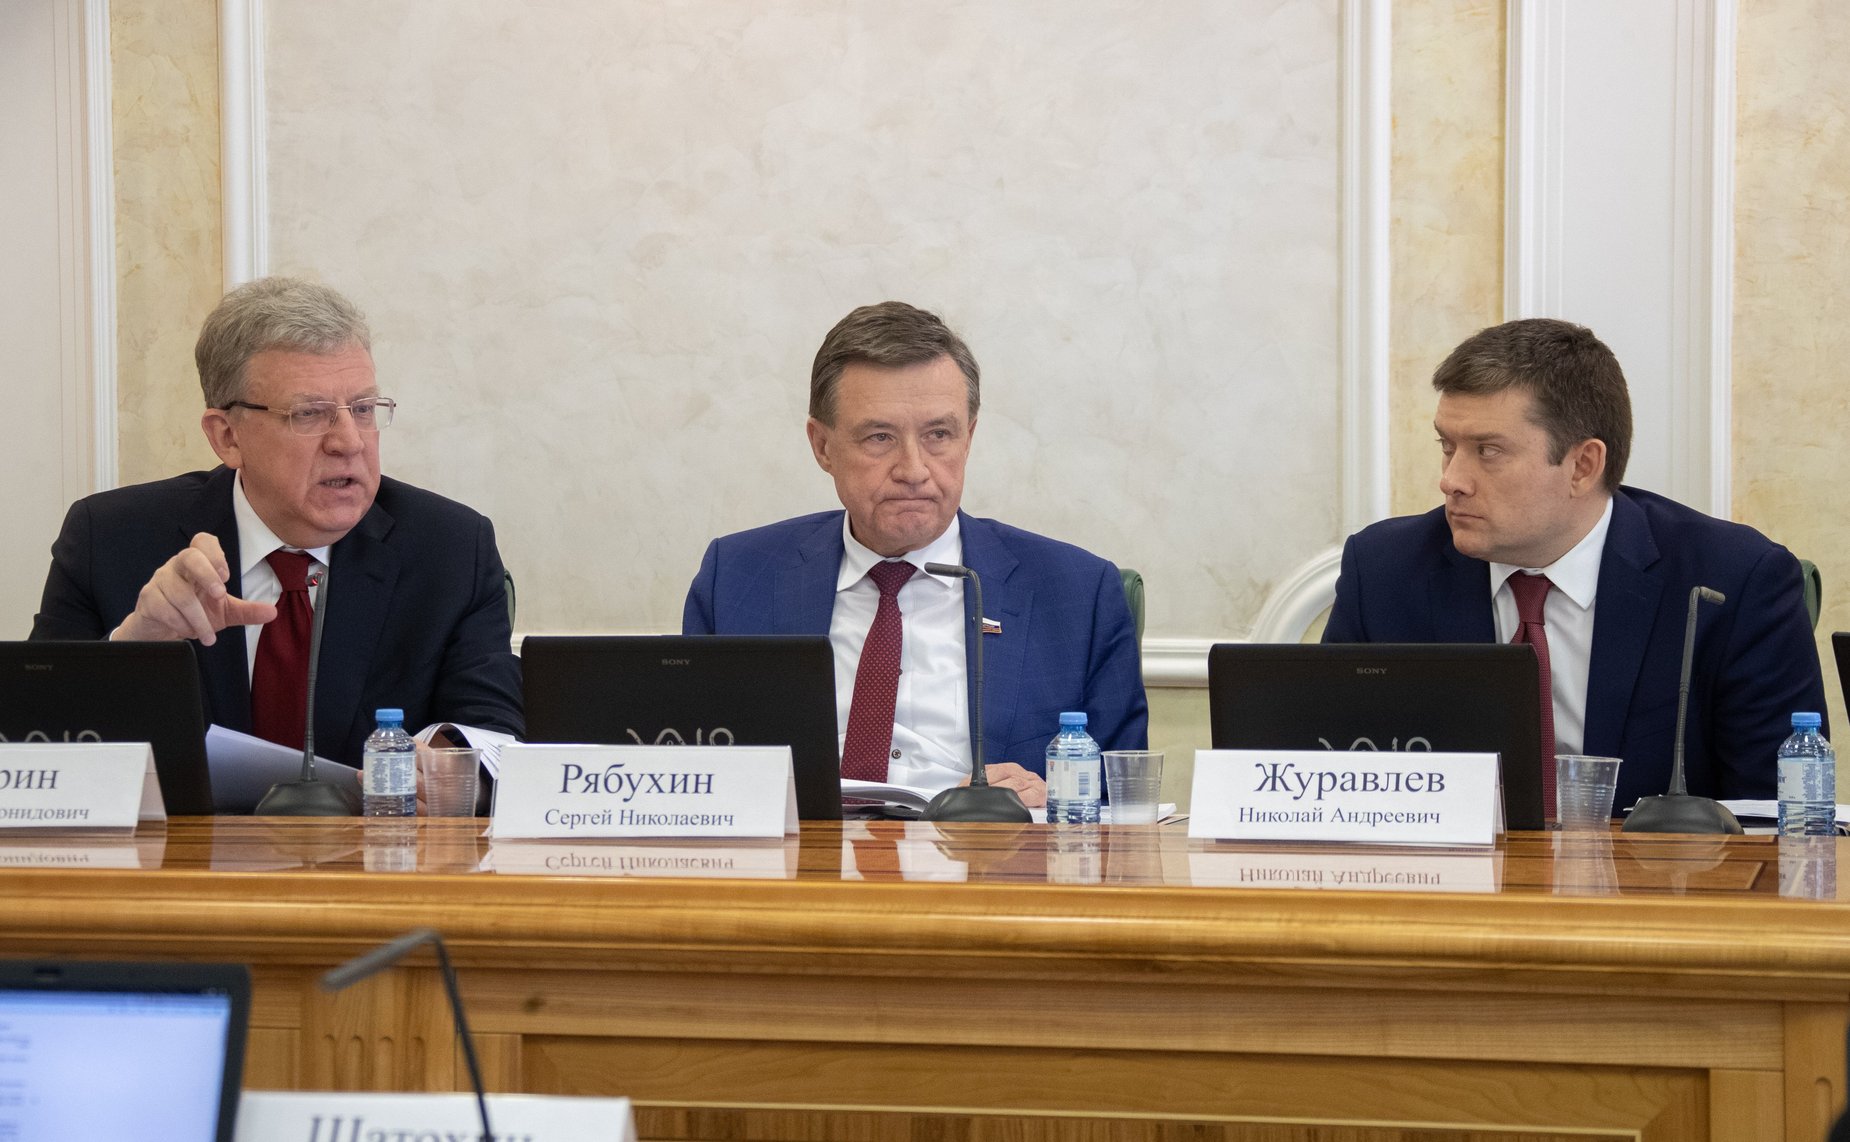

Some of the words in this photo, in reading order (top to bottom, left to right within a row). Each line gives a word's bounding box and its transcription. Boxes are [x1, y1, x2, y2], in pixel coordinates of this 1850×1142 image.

[661, 658, 691, 666] SONY
[1356, 667, 1388, 675] SONY
[558, 762, 715, 803] Рябухин
[1254, 762, 1446, 801] Журавлев
[544, 808, 613, 830] Сергей
[619, 808, 735, 827] Николаевич
[1239, 806, 1323, 824] Николай
[1330, 807, 1441, 828] Андреевич
[308, 1115, 534, 1142] Шатох
